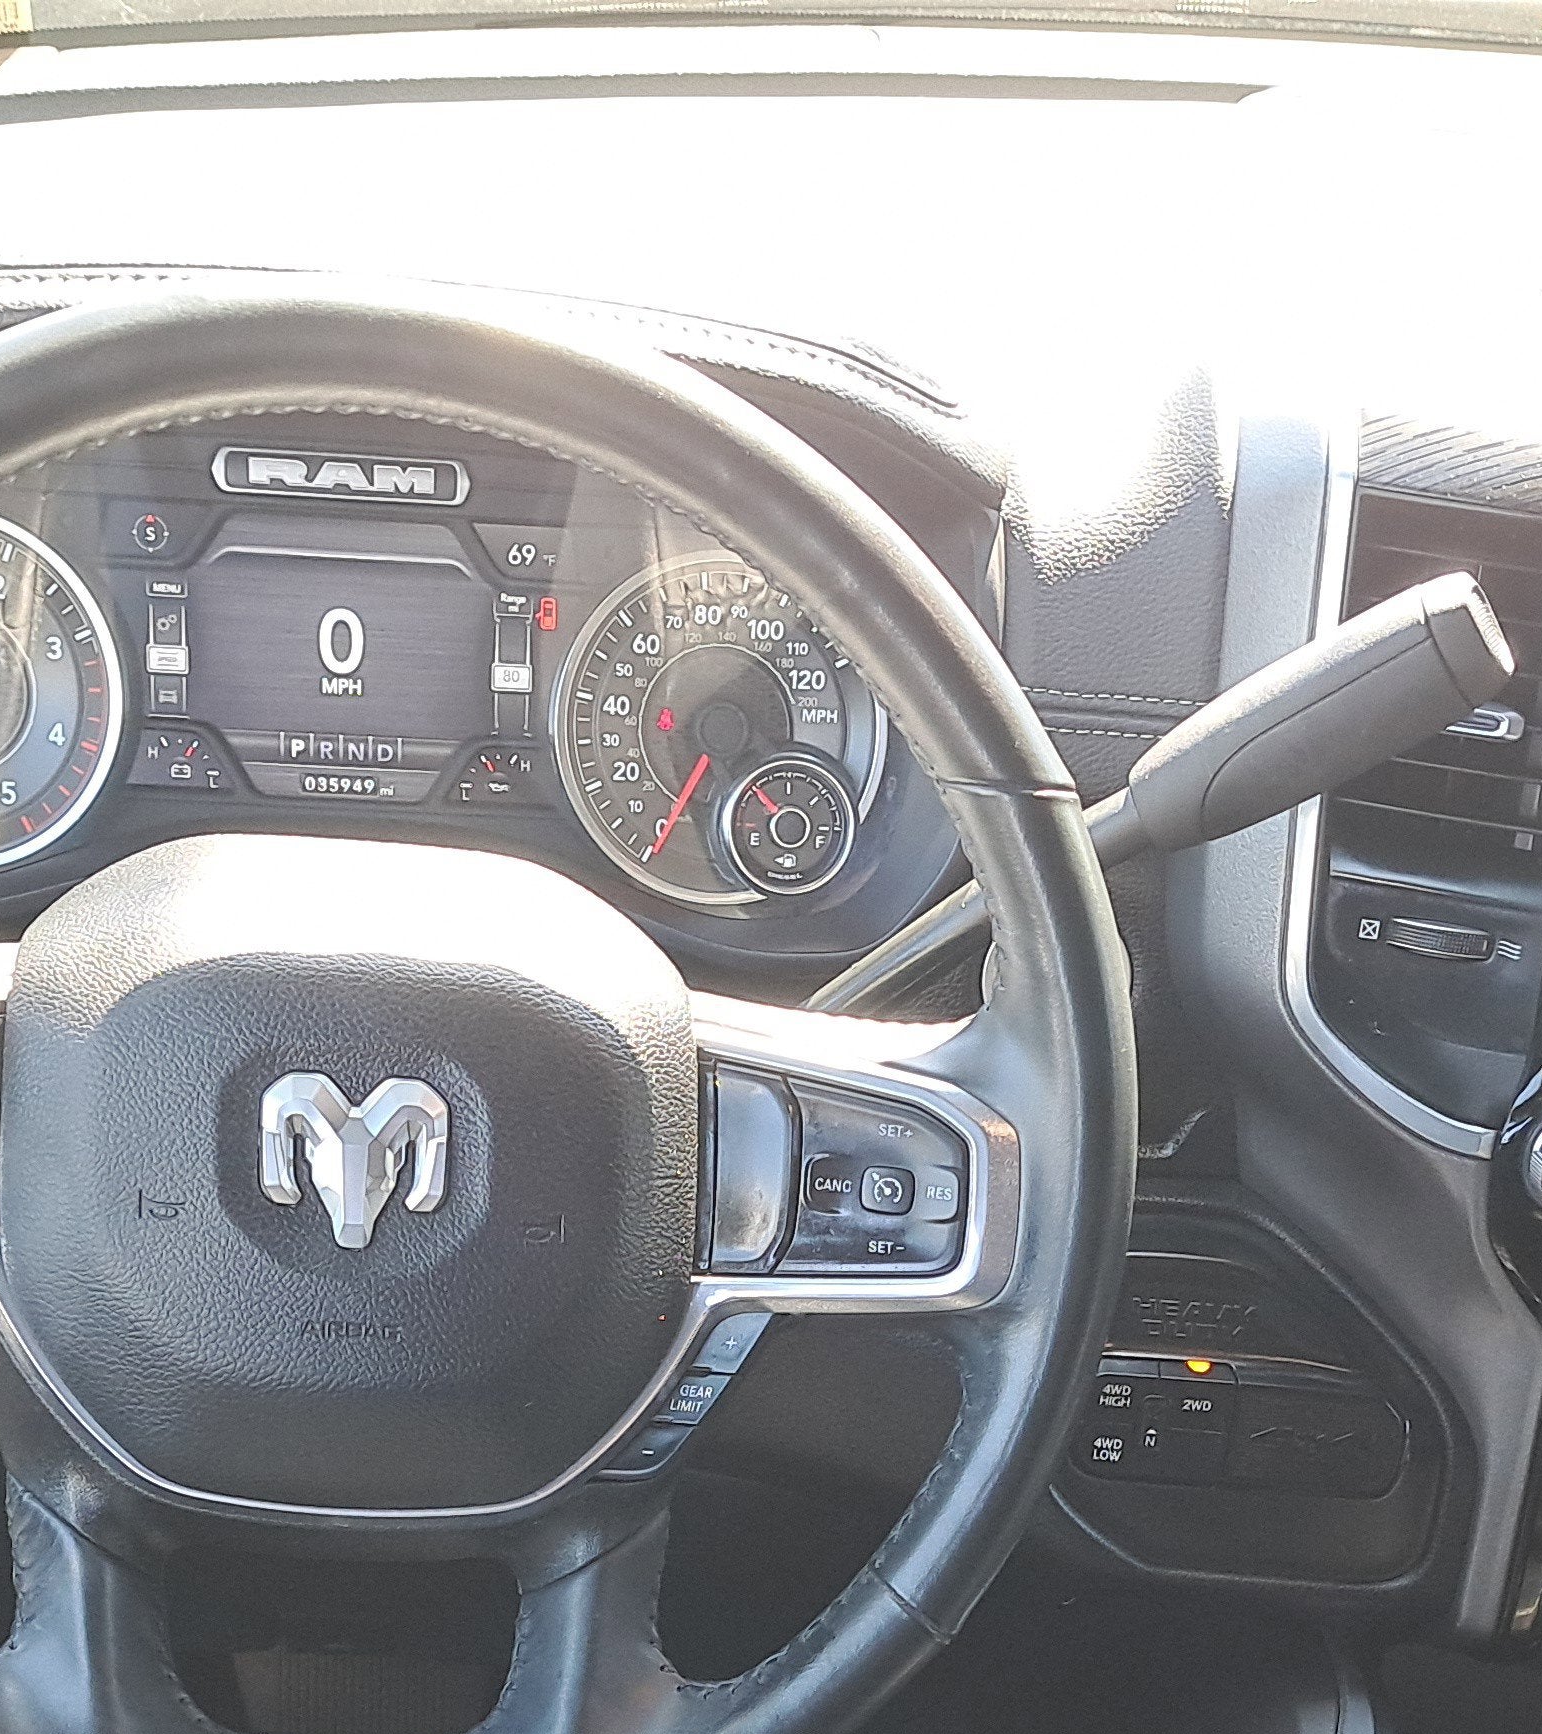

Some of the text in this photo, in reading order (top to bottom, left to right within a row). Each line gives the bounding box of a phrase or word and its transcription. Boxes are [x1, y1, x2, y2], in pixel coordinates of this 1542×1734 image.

[247, 455, 435, 495] RAM
[145, 526, 157, 542] S
[508, 543, 536, 566] 69
[694, 604, 723, 625] 80
[730, 606, 749, 620] 90
[665, 616, 683, 629] 70
[747, 620, 785, 640] 100
[318, 606, 365, 676] 0
[632, 634, 660, 655] 60
[45, 636, 63, 661] 3
[786, 642, 809, 656] 110
[503, 669, 520, 683] 80
[615, 664, 633, 677] 50
[321, 677, 362, 697] MPH
[789, 670, 826, 691] 120
[602, 695, 631, 716] 40
[802, 709, 838, 725] MPH
[47, 722, 66, 746] 4
[602, 733, 621, 748] 30
[147, 746, 159, 760] H
[291, 738, 394, 762] P R N D
[520, 760, 531, 772] H
[612, 761, 641, 782] 20
[210, 776, 219, 789] L
[304, 776, 376, 794] 035949
[0, 781, 17, 805] 5
[462, 789, 470, 801] L
[628, 800, 643, 813] 10
[750, 832, 760, 846] E
[815, 835, 826, 849] F
[926, 1185, 953, 1200] RES
[680, 1384, 713, 1398] GEAR
[1102, 1384, 1132, 1396] 4WD
[670, 1399, 703, 1413] LIMIT
[1099, 1395, 1131, 1408] HIGH
[1182, 1399, 1212, 1412] 2WD
[1093, 1437, 1123, 1450] 4WD
[1144, 1435, 1156, 1447] N
[1092, 1448, 1122, 1462] LOW
